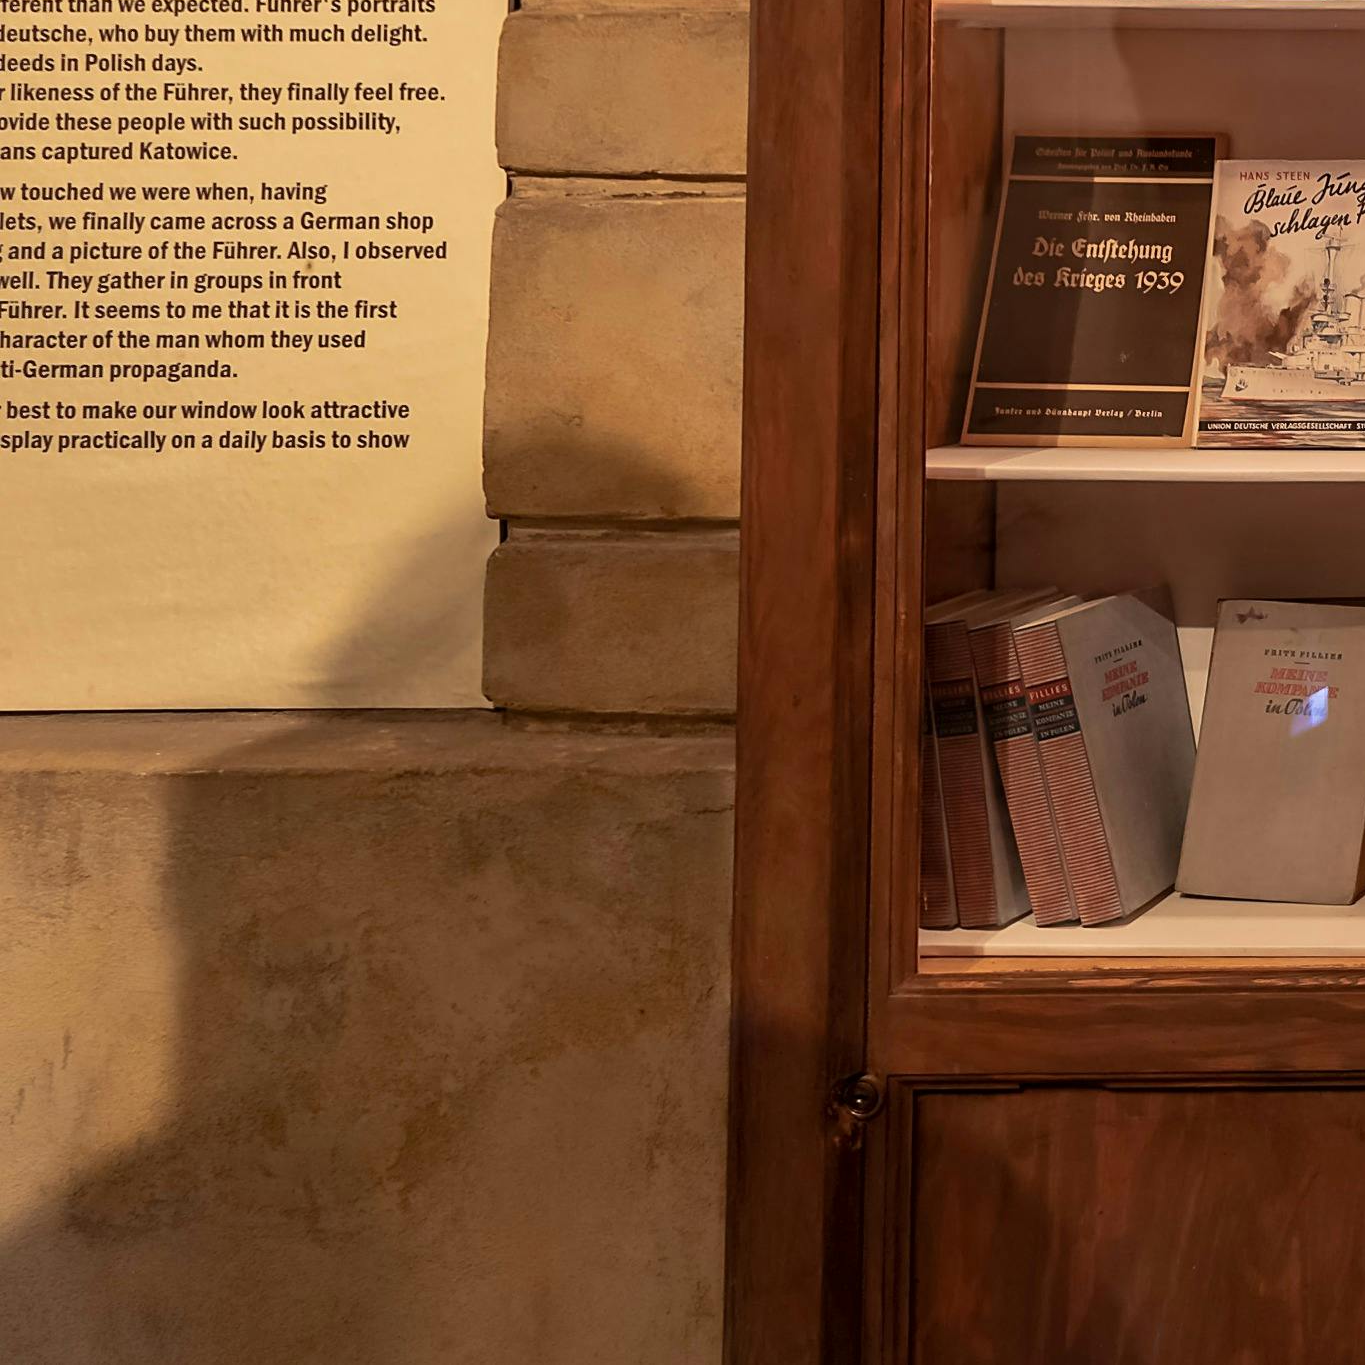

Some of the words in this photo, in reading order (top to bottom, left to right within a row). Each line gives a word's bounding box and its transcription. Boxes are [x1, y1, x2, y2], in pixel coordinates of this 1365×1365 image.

[41, 141, 134, 165] captured
[139, 141, 238, 161] Katowice.
[1239, 171, 1270, 181] HANS
[1275, 171, 1311, 181] STEEN
[1269, 208, 1352, 240] schlagen
[7, 241, 46, 260] and
[51, 245, 64, 260] a
[69, 241, 143, 265] picture
[147, 240, 170, 260] of
[173, 241, 207, 260] the
[212, 241, 282, 260] Führer.
[286, 241, 337, 259] Also,
[343, 240, 350, 260] I
[355, 240, 447, 260] observed
[1032, 236, 1065, 257] Die
[1012, 266, 1045, 286] des
[1054, 265, 1126, 293] Krieges
[1133, 270, 1185, 295] 1939
[1207, 422, 1232, 430] UNION
[1233, 422, 1269, 430] DEUTSCHE
[57, 430, 167, 454] practically
[171, 434, 196, 449] on
[201, 434, 213, 449] a
[218, 429, 268, 454] daily
[271, 429, 326, 449] basis
[331, 430, 352, 449] to
[356, 429, 411, 449] show
[1029, 683, 1069, 701] FILLIES
